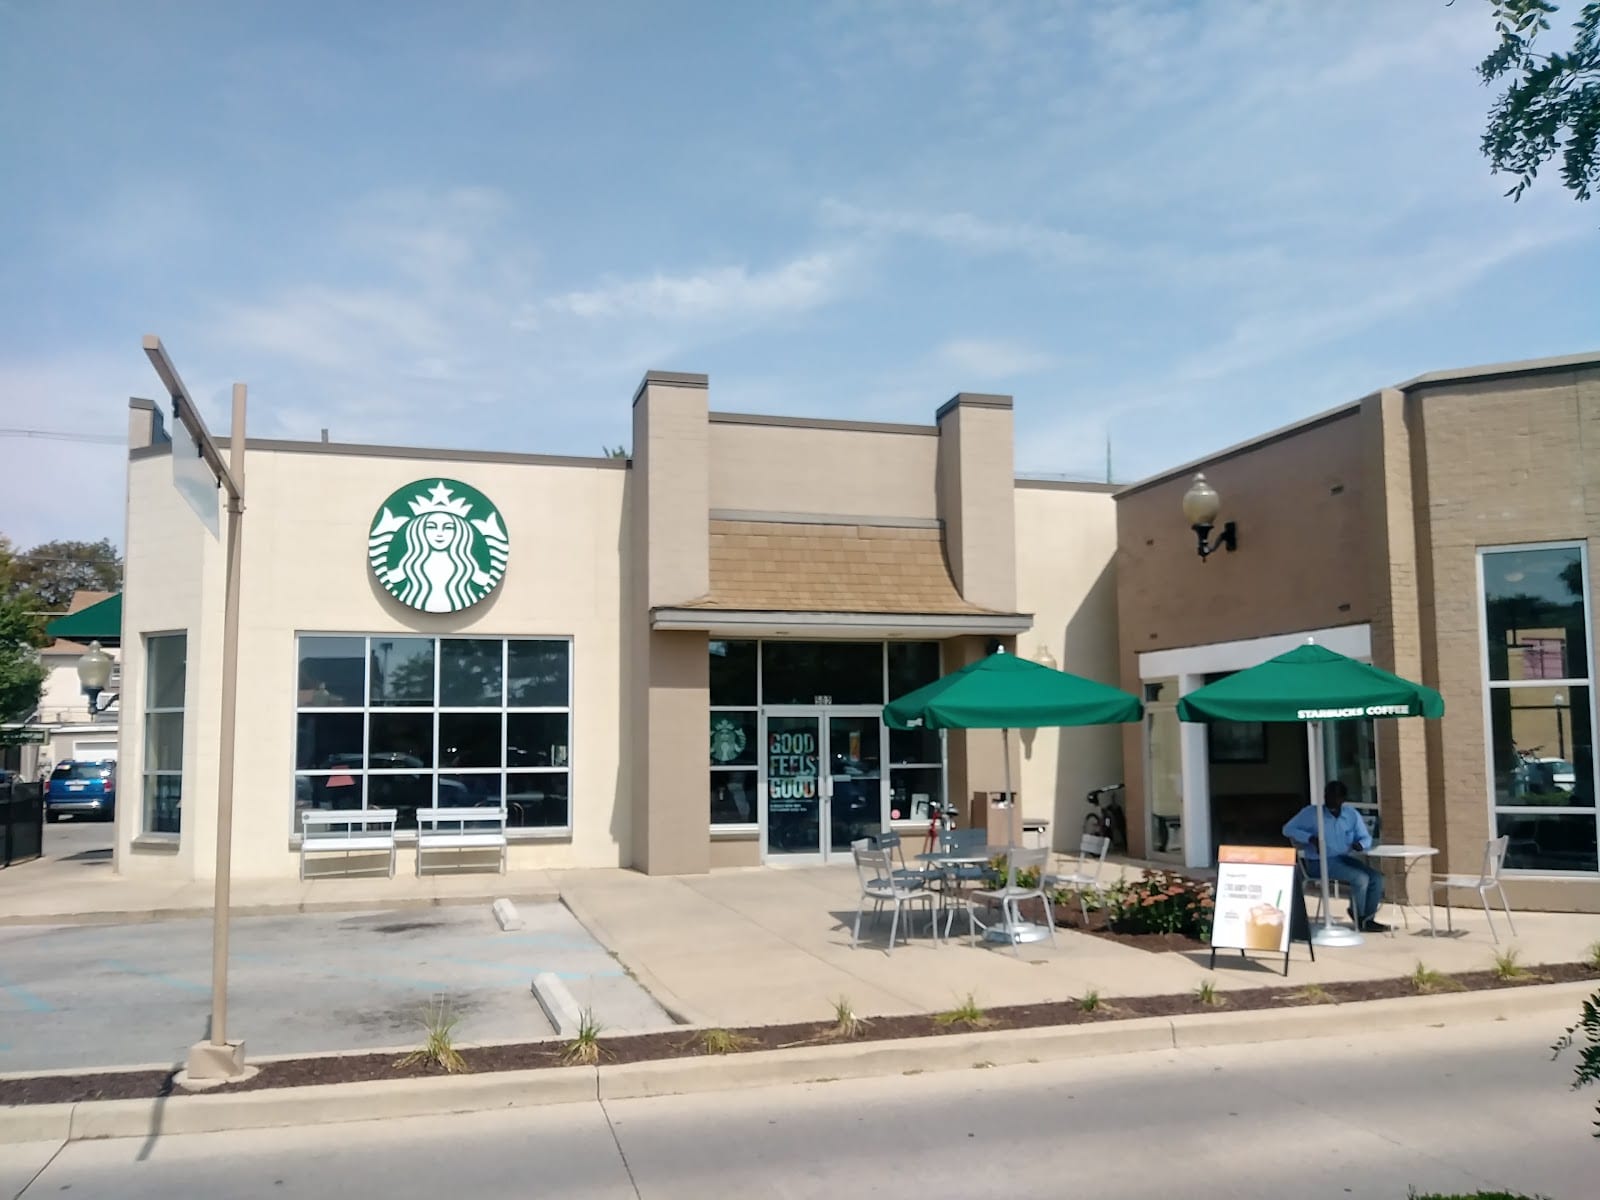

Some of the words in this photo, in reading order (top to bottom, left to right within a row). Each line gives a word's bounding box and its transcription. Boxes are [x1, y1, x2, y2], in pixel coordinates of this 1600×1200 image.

[1297, 708, 1364, 719] STARBUCKS
[1366, 704, 1409, 716] COFFEE
[769, 733, 815, 754] GOOD
[769, 754, 817, 776] FEELS
[769, 777, 816, 799] GOOD
